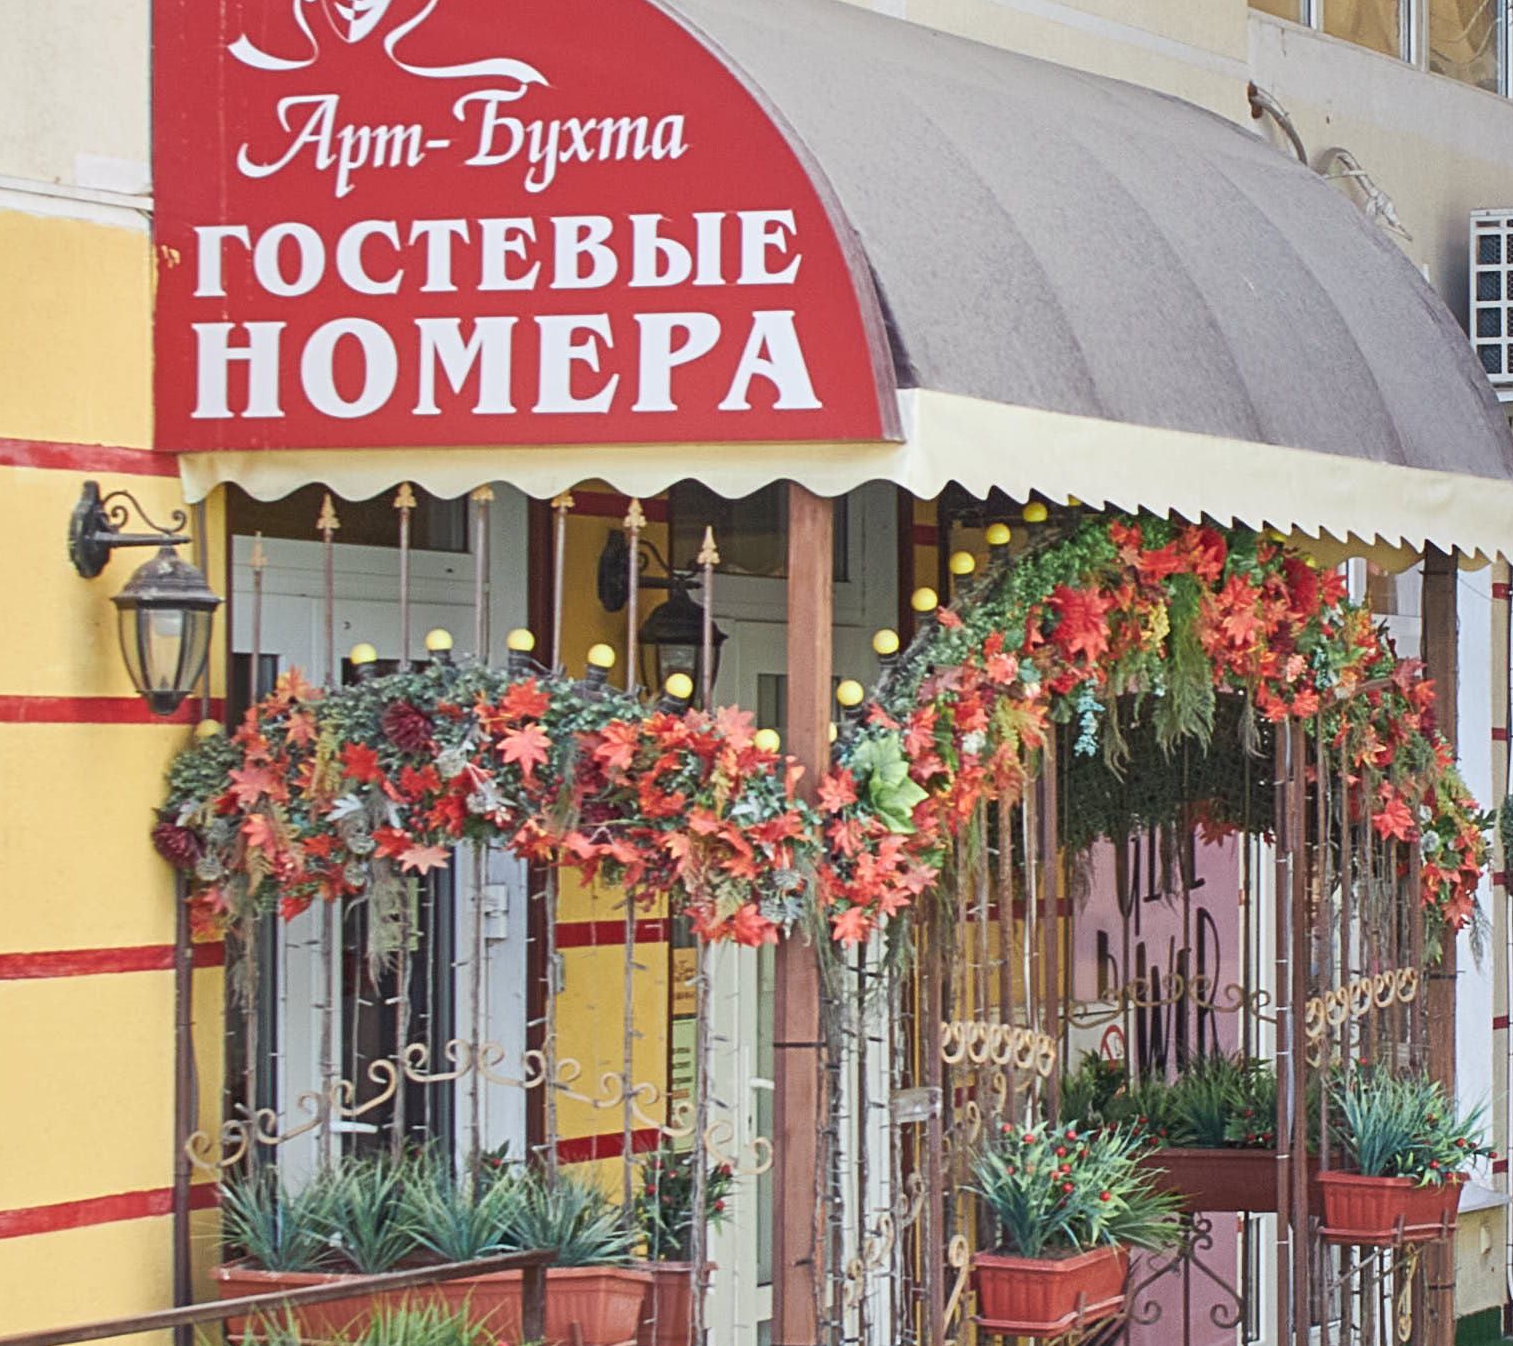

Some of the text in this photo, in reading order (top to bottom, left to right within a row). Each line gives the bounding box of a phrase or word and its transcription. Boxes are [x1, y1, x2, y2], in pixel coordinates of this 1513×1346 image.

[237, 84, 689, 197] Арт-Бухта
[192, 208, 803, 299] ГОСТЕВЫЕ
[190, 310, 823, 419] НОМЕРА
